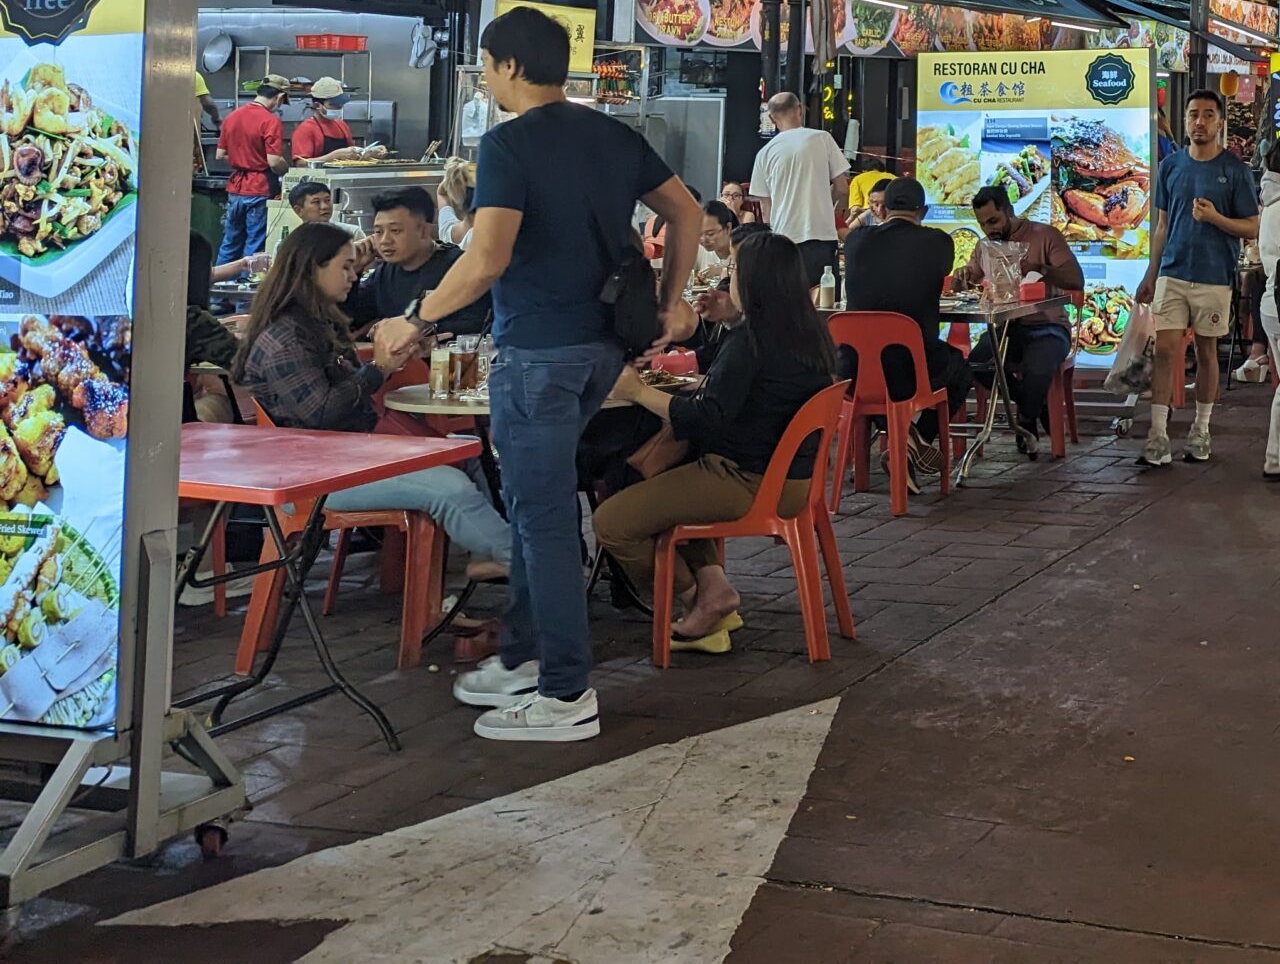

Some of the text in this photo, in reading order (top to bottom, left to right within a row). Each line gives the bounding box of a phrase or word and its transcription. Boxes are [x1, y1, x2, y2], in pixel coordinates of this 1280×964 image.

[933, 61, 1046, 76] RESTORAN CU CHA
[1092, 78, 1127, 88] Seafood
